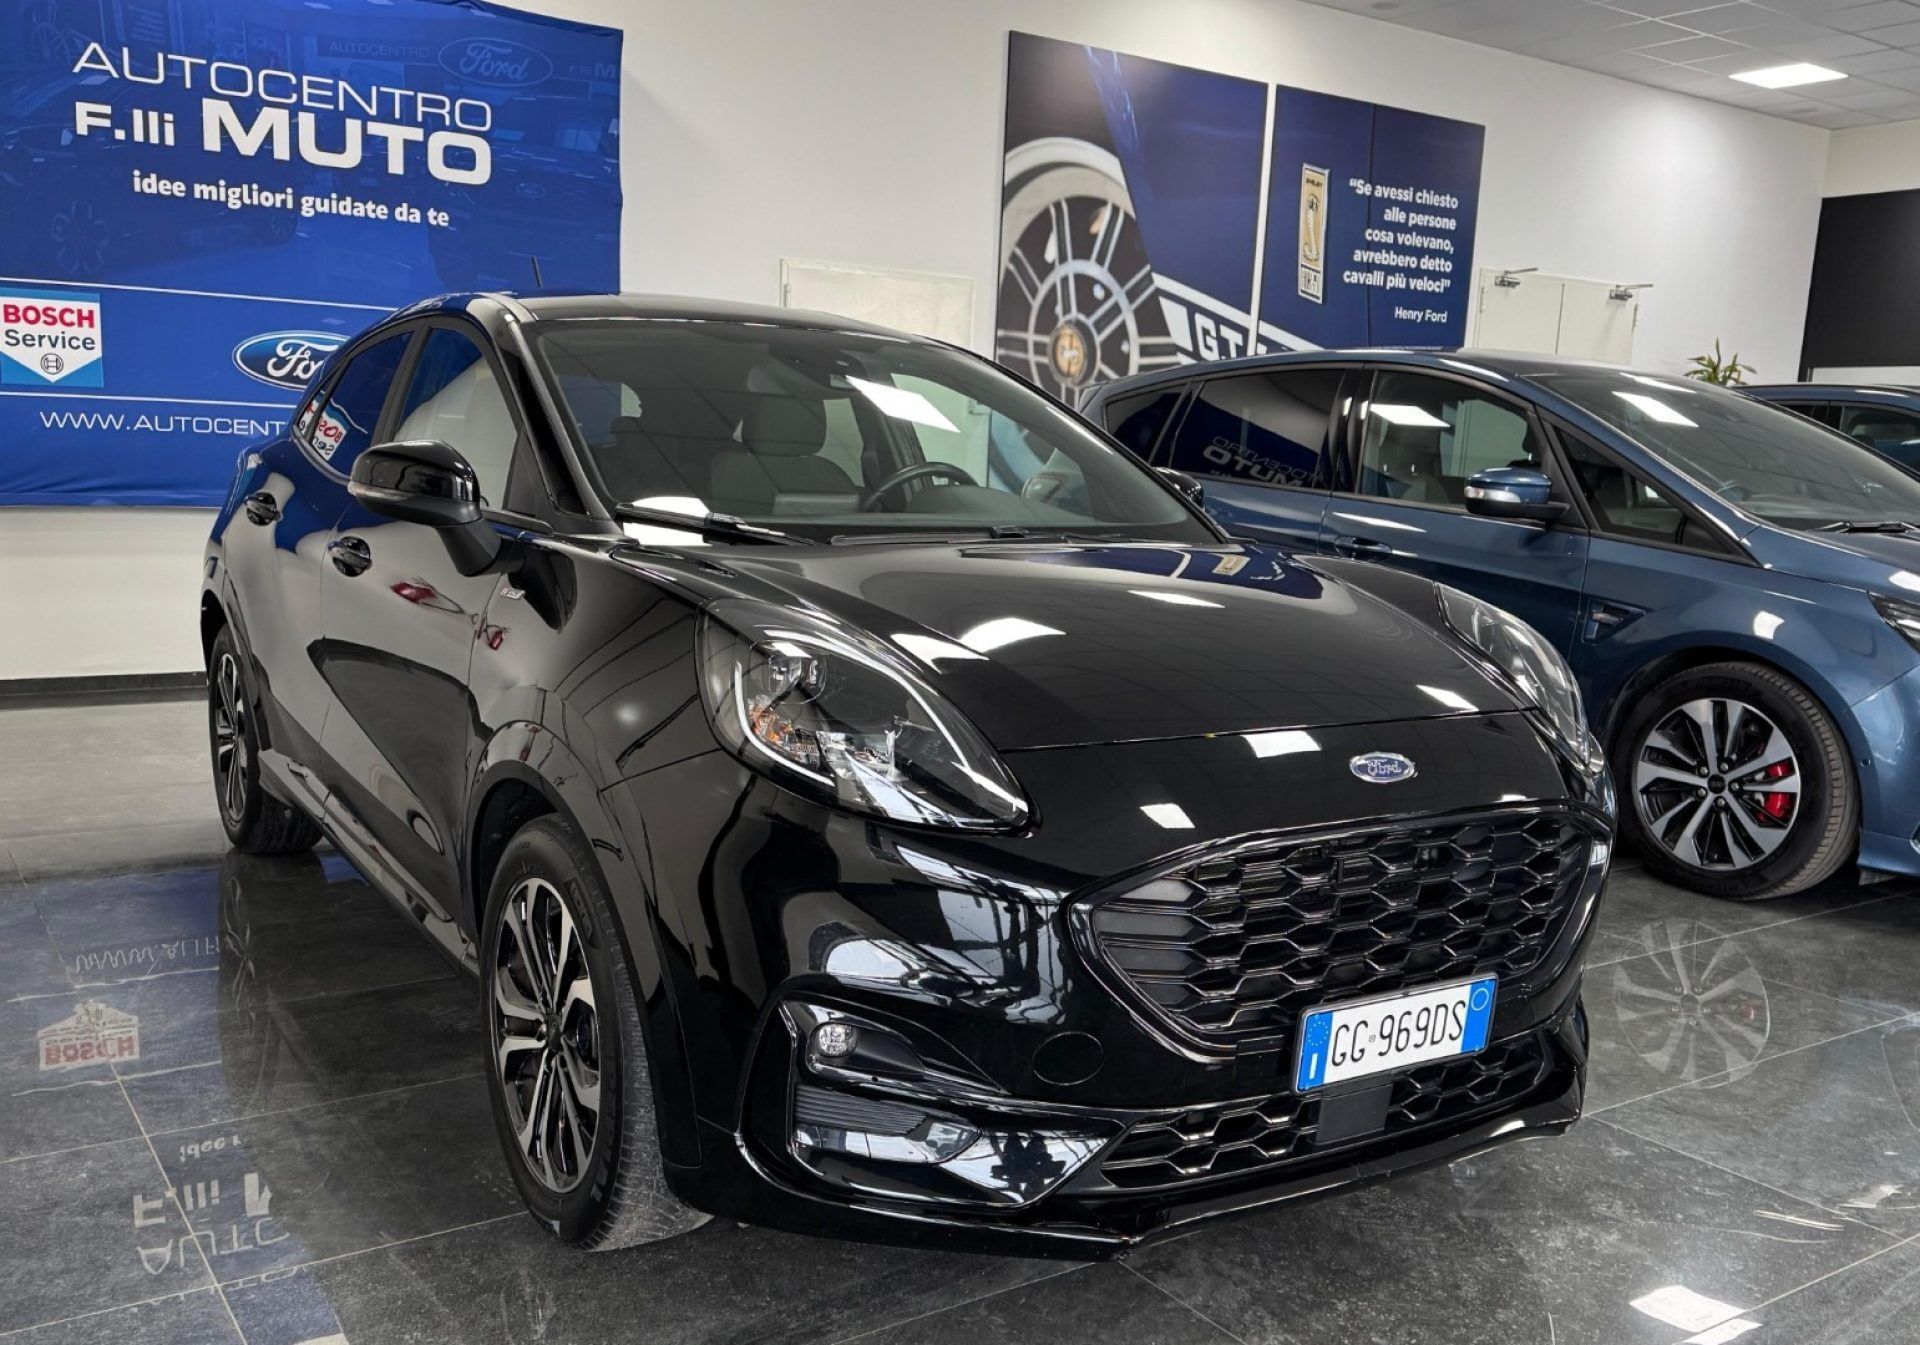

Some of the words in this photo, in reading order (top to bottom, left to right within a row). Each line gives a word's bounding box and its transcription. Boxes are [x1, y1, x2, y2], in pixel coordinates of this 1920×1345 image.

[460, 42, 530, 80] Ford
[72, 41, 492, 132] AUTOCENTRO
[202, 97, 492, 186] MUTO
[133, 169, 186, 198] idee
[193, 179, 294, 209] migliori
[300, 192, 389, 219] guidate
[394, 202, 421, 224] da
[427, 207, 450, 227] te
[1374, 184, 1414, 203] avessi
[1415, 189, 1460, 209] chiesto
[1384, 206, 1407, 223] alle
[1408, 211, 1457, 231] persone
[1365, 228, 1394, 244] cosa
[1397, 231, 1455, 254] volevano,
[1353, 248, 1418, 269] avrebbero
[1420, 254, 1453, 273] detto
[1343, 269, 1385, 287] cavalli
[1386, 271, 1407, 290] più
[3, 303, 95, 329] BOSCH
[1394, 306, 1424, 323] Henry
[1425, 309, 1448, 323] Ford
[4, 328, 96, 351] Service
[1331, 1019, 1369, 1067] GG
[1378, 999, 1467, 1058] 969DS
